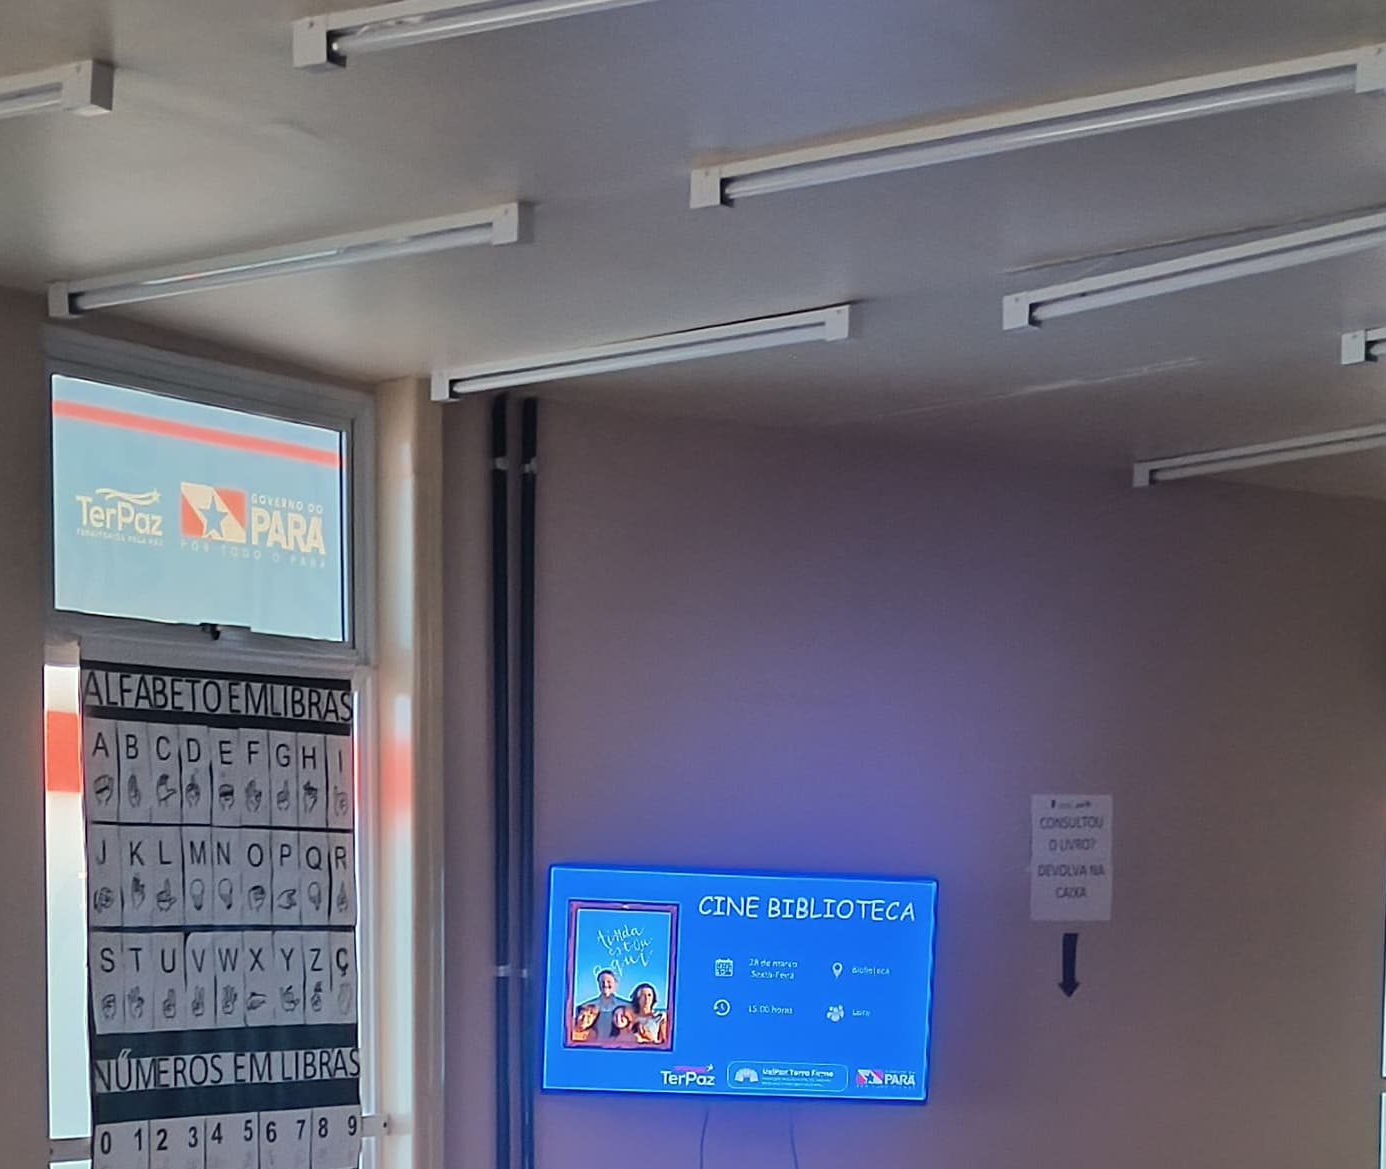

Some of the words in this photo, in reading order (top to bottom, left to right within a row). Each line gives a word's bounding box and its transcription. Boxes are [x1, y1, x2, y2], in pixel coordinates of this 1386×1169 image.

[74, 494, 163, 537] TerPaz
[250, 493, 304, 512] GOVERNO
[307, 502, 324, 515] DO
[85, 670, 222, 713] ALFABETO
[228, 682, 269, 715] EM
[270, 686, 353, 722] LIBRAS
[92, 732, 110, 758] A
[125, 734, 139, 760] B
[156, 736, 171, 760] C
[187, 738, 201, 763] D
[219, 740, 233, 765] E
[248, 740, 261, 764] F
[276, 744, 290, 767] G
[302, 746, 316, 769] H
[337, 750, 343, 773] I
[96, 840, 106, 865] J
[130, 841, 144, 866] K
[159, 841, 172, 866] L
[190, 842, 207, 865] M
[217, 842, 231, 865] N
[247, 843, 263, 867] O
[279, 844, 291, 867] P
[306, 846, 322, 872] Q
[335, 847, 347, 869] R
[698, 896, 761, 918] CINE
[767, 897, 916, 922] BIBLIOTECA
[100, 948, 114, 973] S
[131, 948, 142, 972] T
[161, 948, 176, 973] U
[192, 949, 205, 973] V
[218, 948, 239, 972] W
[249, 949, 264, 972] X
[280, 948, 294, 971] Y
[310, 948, 323, 972] Z
[335, 948, 349, 977] Ç
[94, 1048, 223, 1091] NÚMEROS
[233, 1052, 272, 1083] EM
[281, 1048, 361, 1081] LIBRAS
[660, 1070, 716, 1086] TerPaz
[100, 1131, 112, 1155] 0
[134, 1129, 143, 1152] 1
[157, 1129, 168, 1151] 2
[188, 1127, 198, 1148] 3
[211, 1122, 223, 1145] 4
[244, 1120, 254, 1142] 5
[266, 1121, 277, 1143] 6
[296, 1119, 306, 1140] 7
[318, 1117, 329, 1138] 8
[348, 1115, 357, 1136] 9
